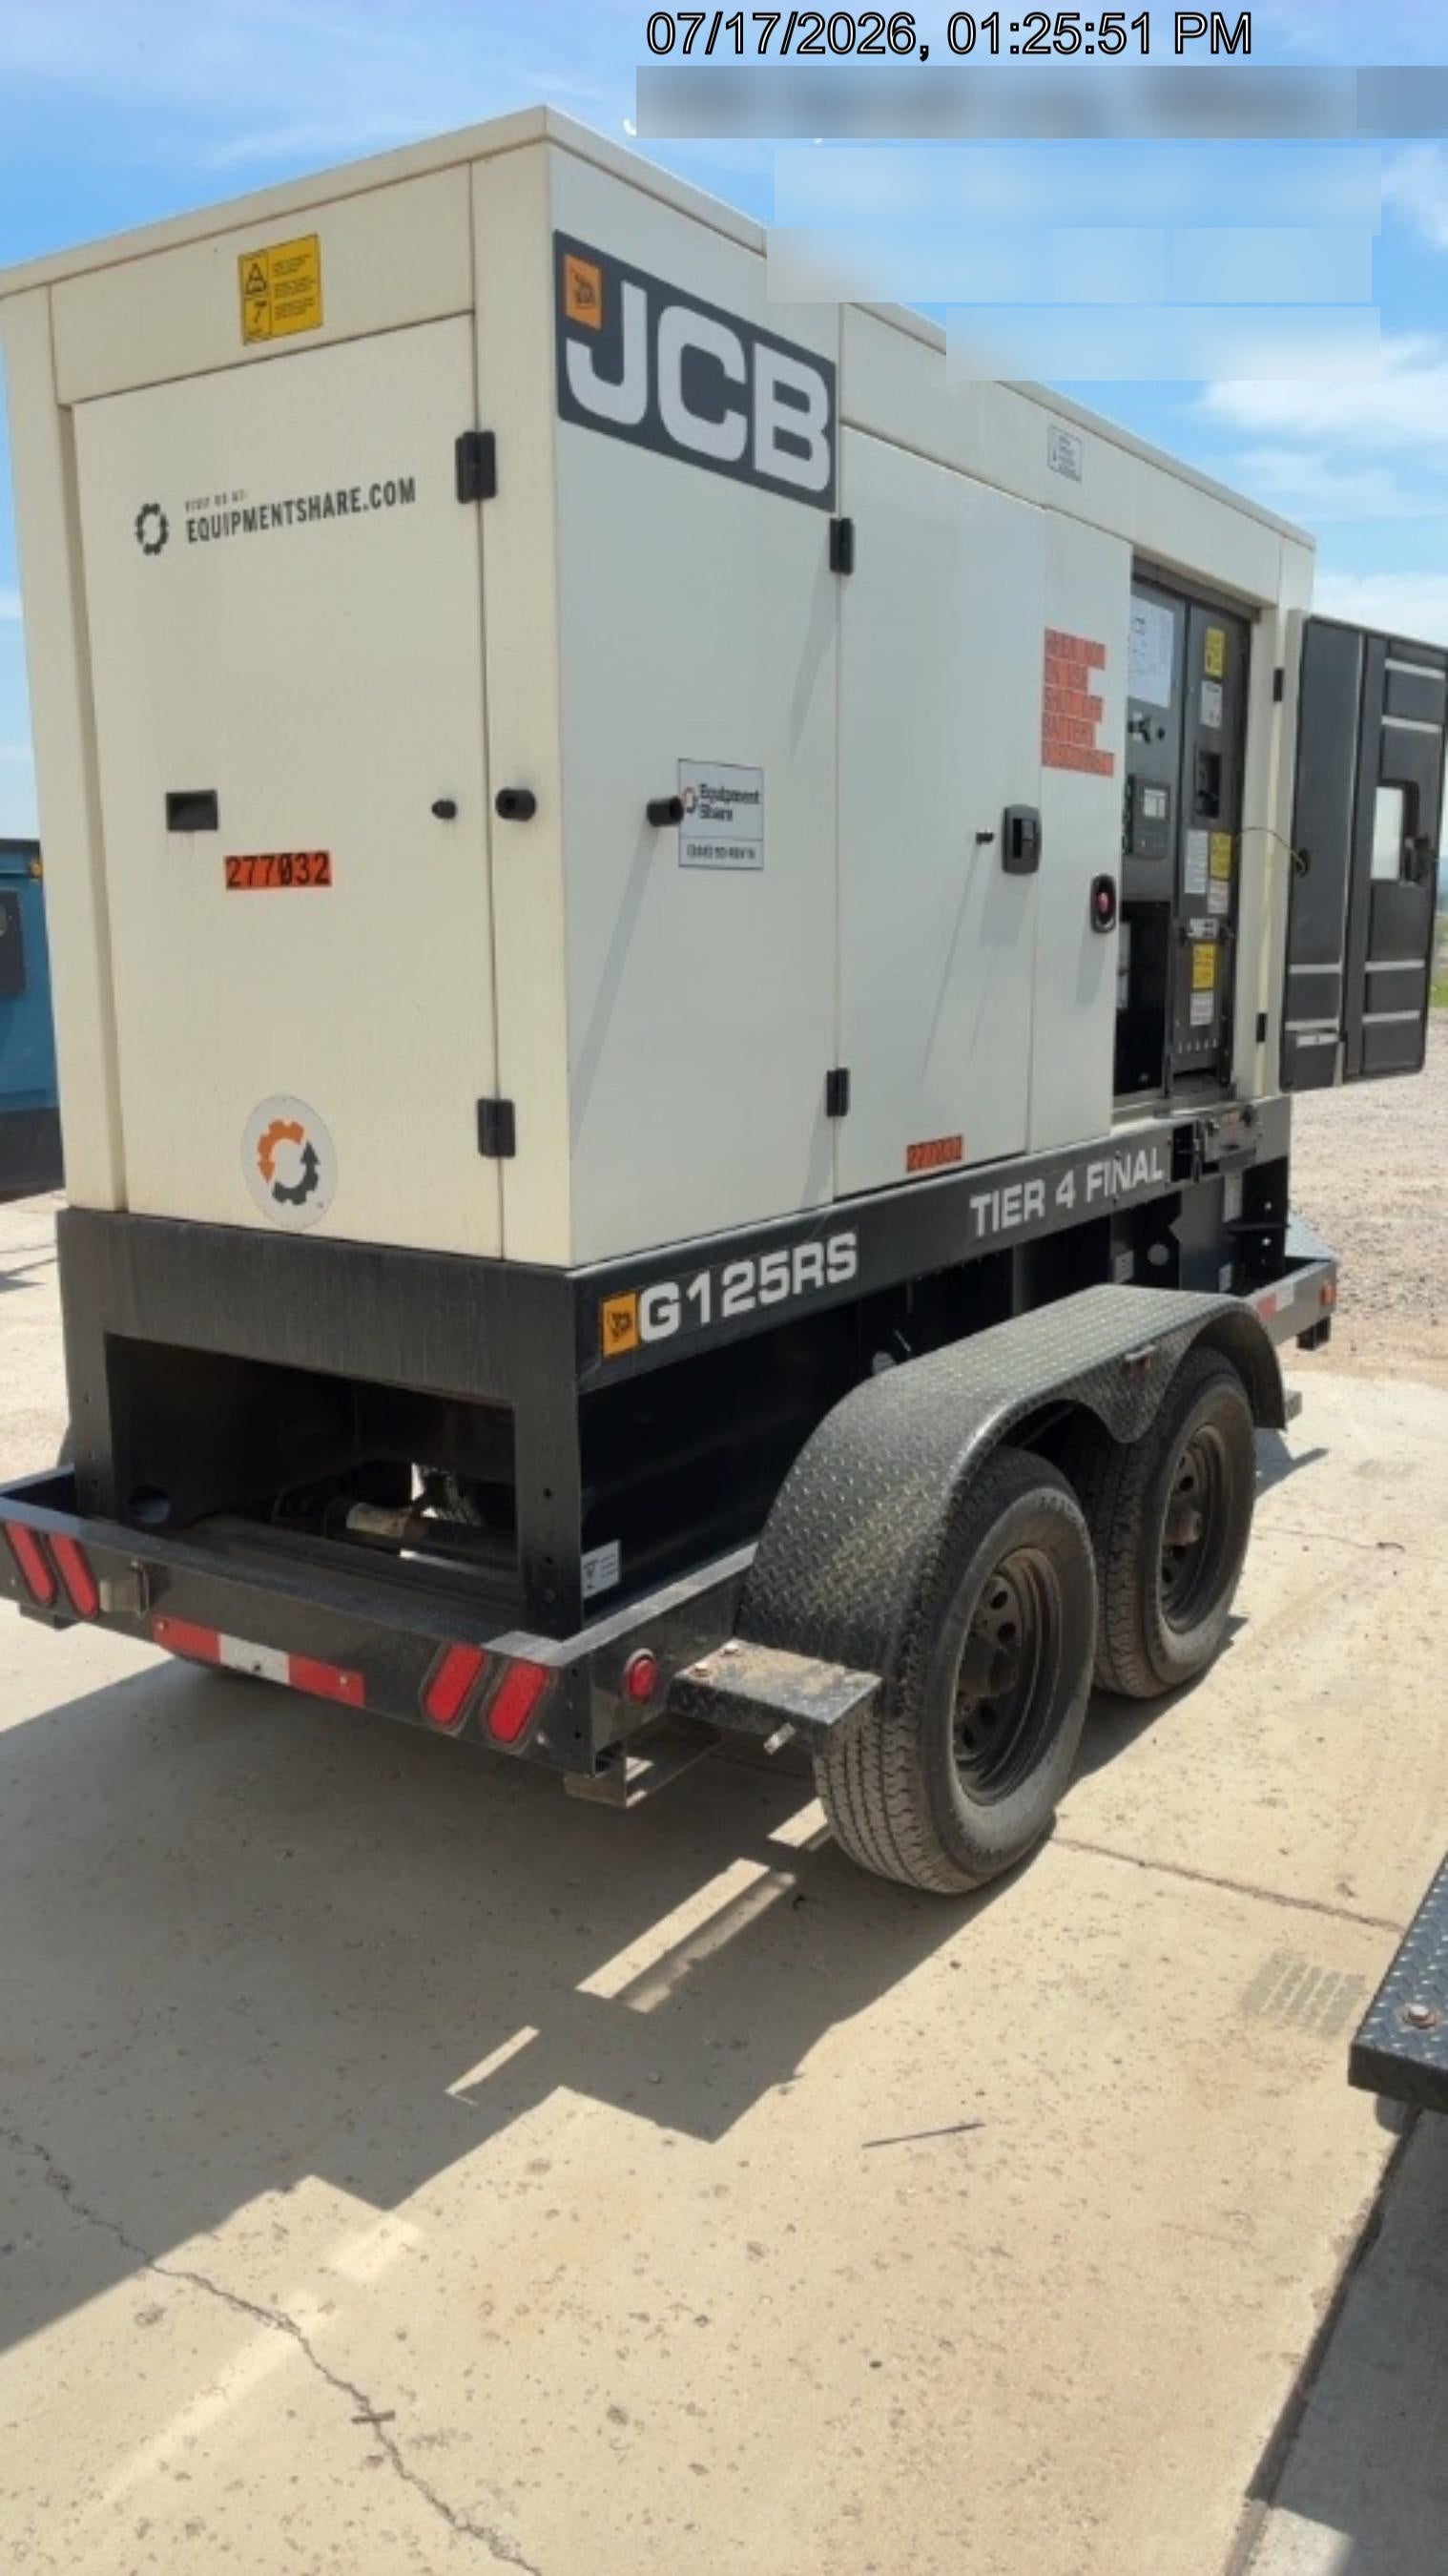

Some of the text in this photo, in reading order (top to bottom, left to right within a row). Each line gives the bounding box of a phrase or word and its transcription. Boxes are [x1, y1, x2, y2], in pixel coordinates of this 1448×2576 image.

[566, 280, 831, 492] JCB
[186, 477, 416, 544] EQUIPMENTSHARE.COM
[225, 851, 331, 888] 277032
[969, 1147, 1164, 1237] TIER 4 FINAL
[640, 1232, 857, 1343] G125RS
